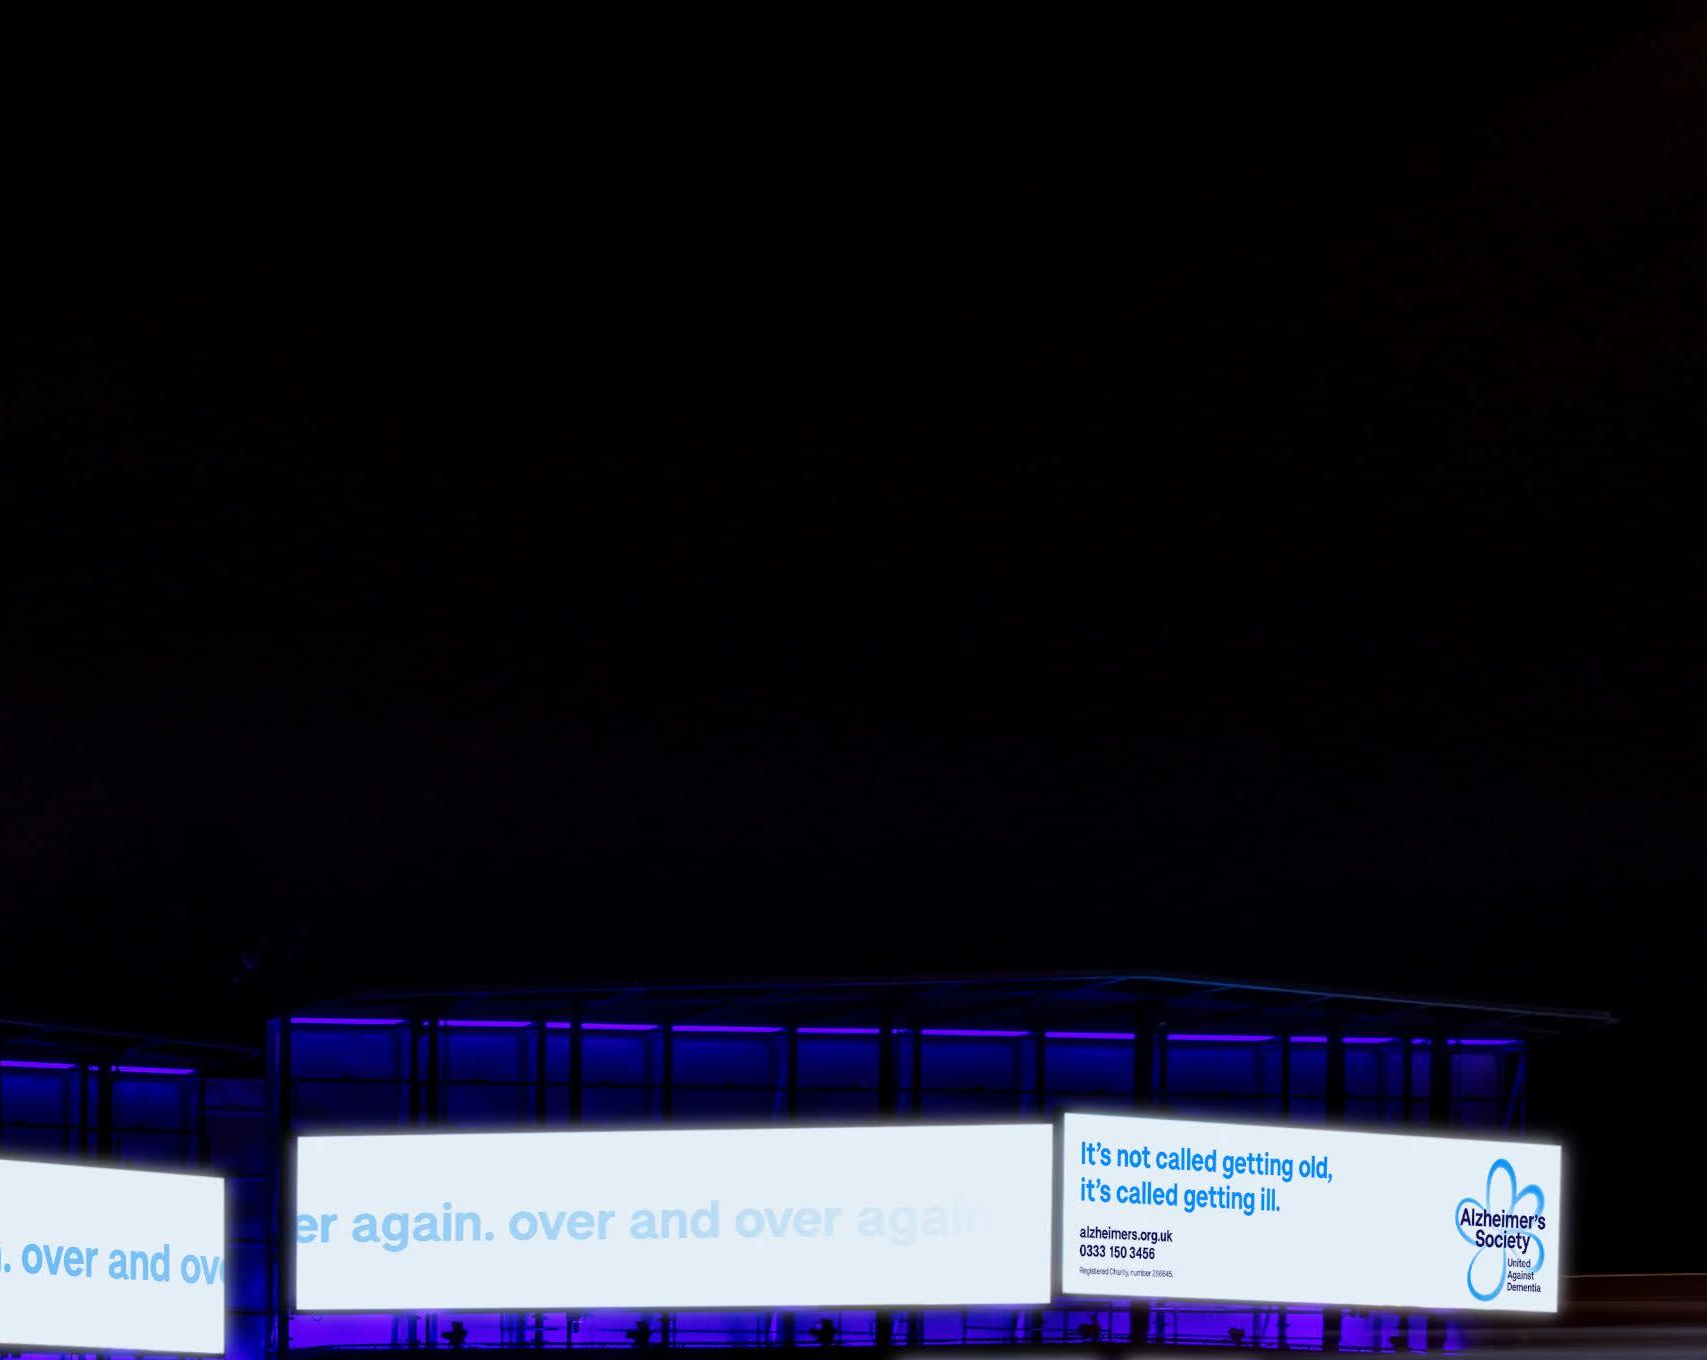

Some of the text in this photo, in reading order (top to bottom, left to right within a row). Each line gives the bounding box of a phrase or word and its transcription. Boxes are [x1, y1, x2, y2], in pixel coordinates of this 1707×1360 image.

[1080, 1141, 1333, 1183] It's not called getting old,
[1080, 1177, 1281, 1216] it's called getting ill.
[347, 1200, 495, 1254] again.
[508, 1208, 616, 1241] over
[629, 1200, 719, 1240] and
[735, 1207, 841, 1239] over
[1460, 1207, 1546, 1231] Alzheimer's
[1079, 1225, 1173, 1245] alzheimers.org.uk
[1475, 1229, 1531, 1255] Society
[22, 1243, 98, 1278] over
[109, 1244, 170, 1282] and
[1079, 1244, 1156, 1260] 0333 150 3456
[1507, 1258, 1531, 1268] United
[1506, 1282, 1541, 1293] Dementia
[1507, 1270, 1534, 1281] Against
